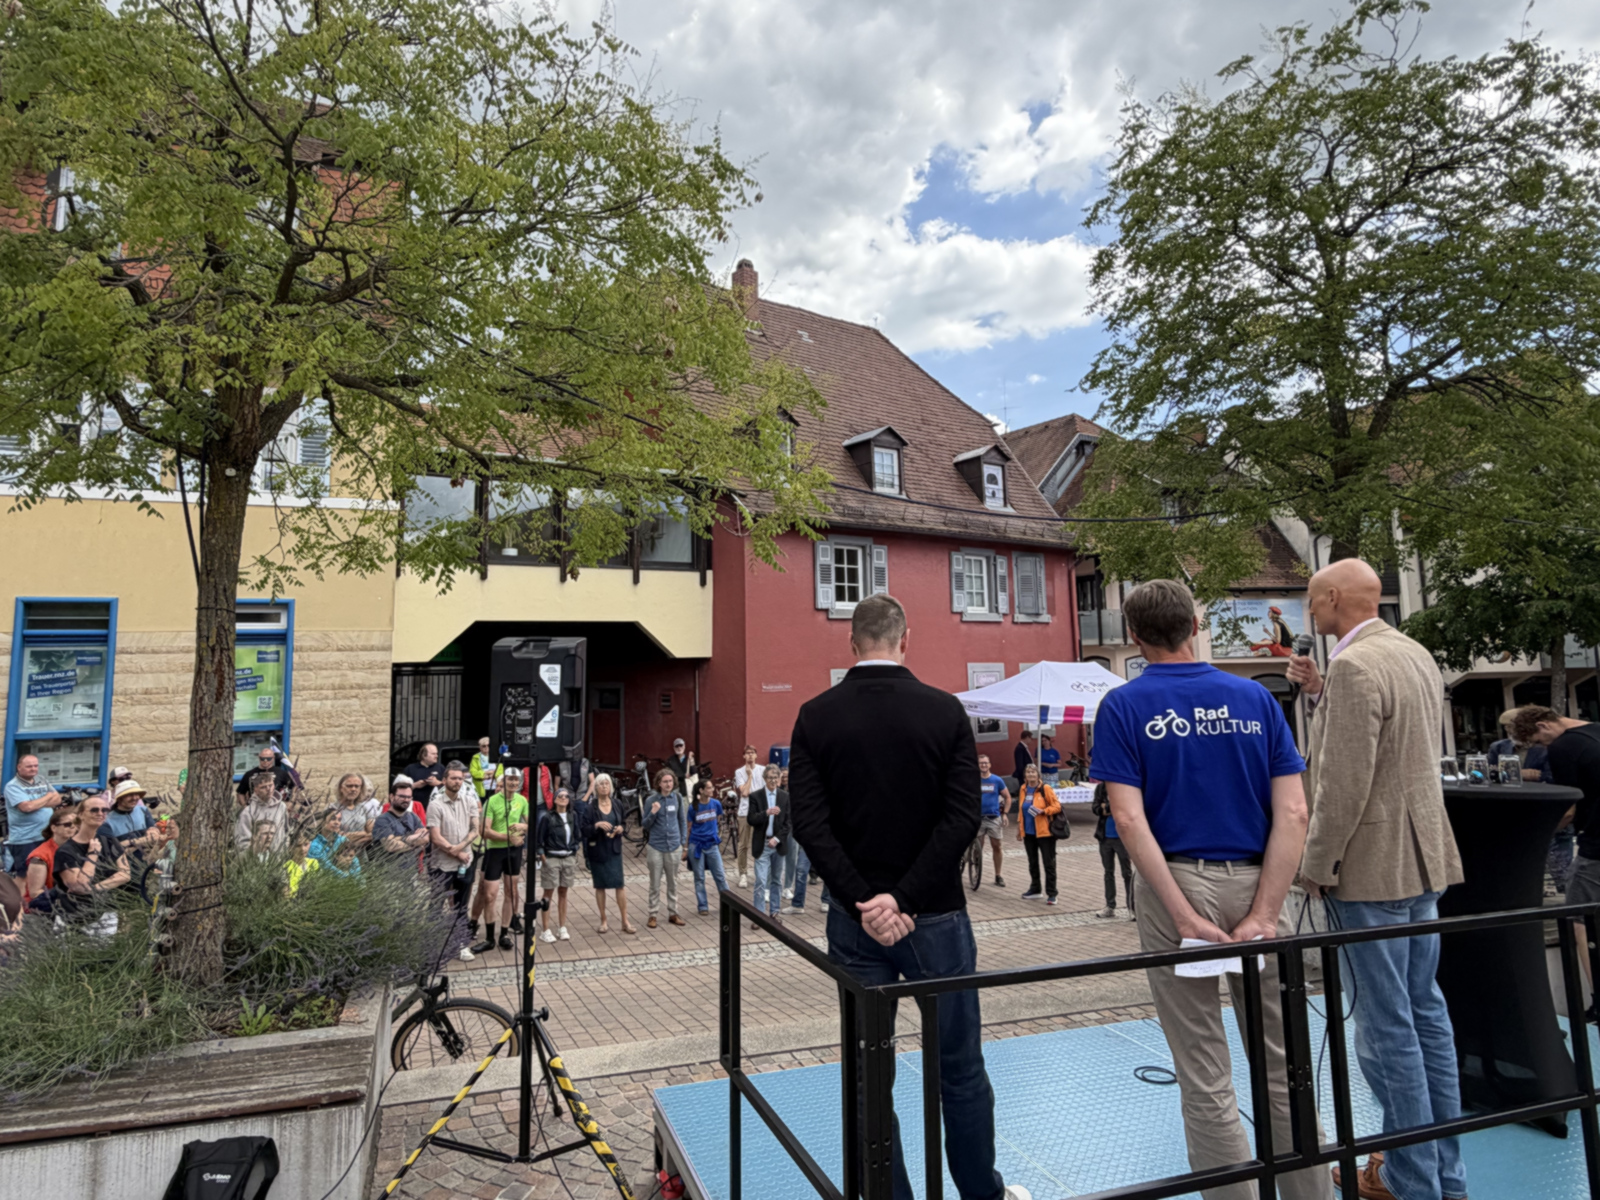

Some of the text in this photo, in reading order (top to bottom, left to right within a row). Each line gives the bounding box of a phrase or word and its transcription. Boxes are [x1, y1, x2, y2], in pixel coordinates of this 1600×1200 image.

[43, 680, 76, 688] Trauerportal
[1194, 705, 1229, 721] Rad
[1195, 719, 1262, 736] KULTUR
